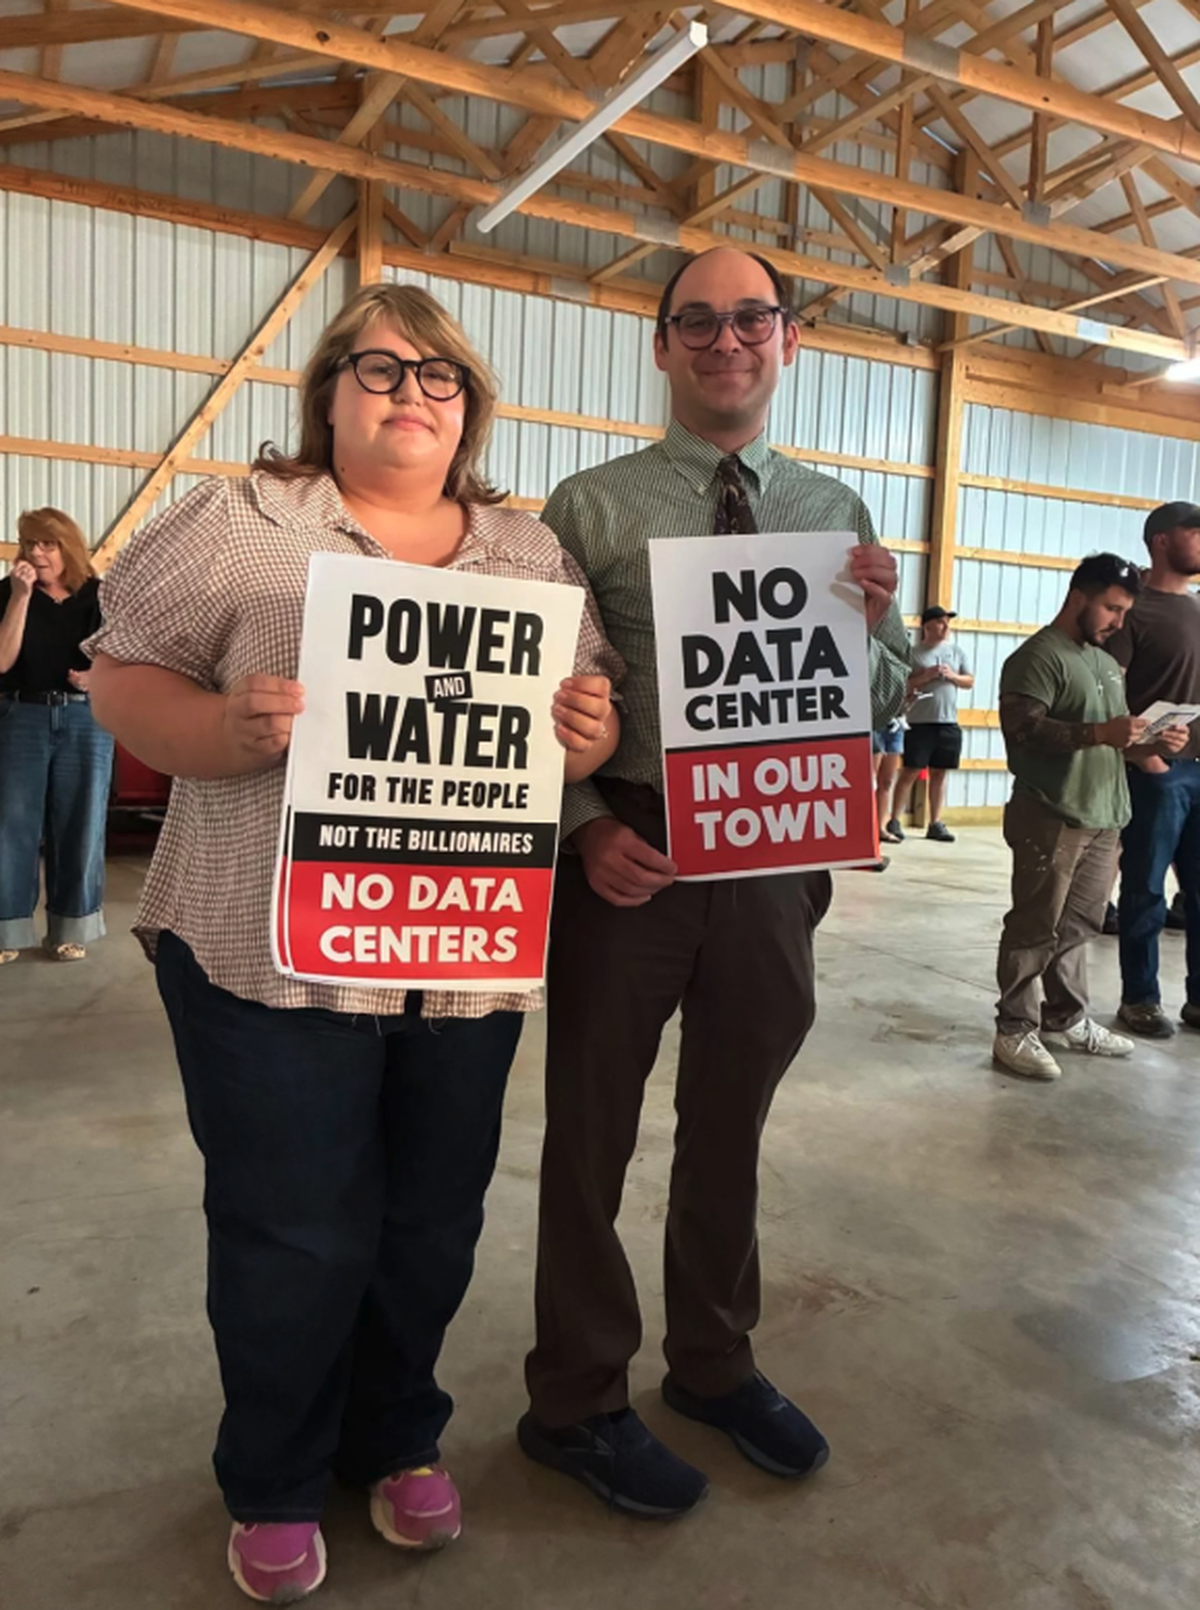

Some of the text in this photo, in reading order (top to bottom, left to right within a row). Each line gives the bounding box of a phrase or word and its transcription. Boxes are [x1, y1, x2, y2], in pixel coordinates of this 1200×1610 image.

[712, 567, 808, 623] NO
[347, 594, 545, 676] POWER
[681, 625, 849, 689] DATA
[433, 677, 465, 698] AND
[685, 685, 850, 730] CENTER
[345, 692, 532, 770] WATER
[327, 773, 530, 809] FOR THE PEOPLE
[692, 753, 851, 802] IN OUR
[319, 825, 534, 854] NOT THE BILLIONAIRES
[694, 799, 847, 850] TOWN
[321, 873, 523, 912] NO DATA
[319, 926, 519, 963] CENTERS
